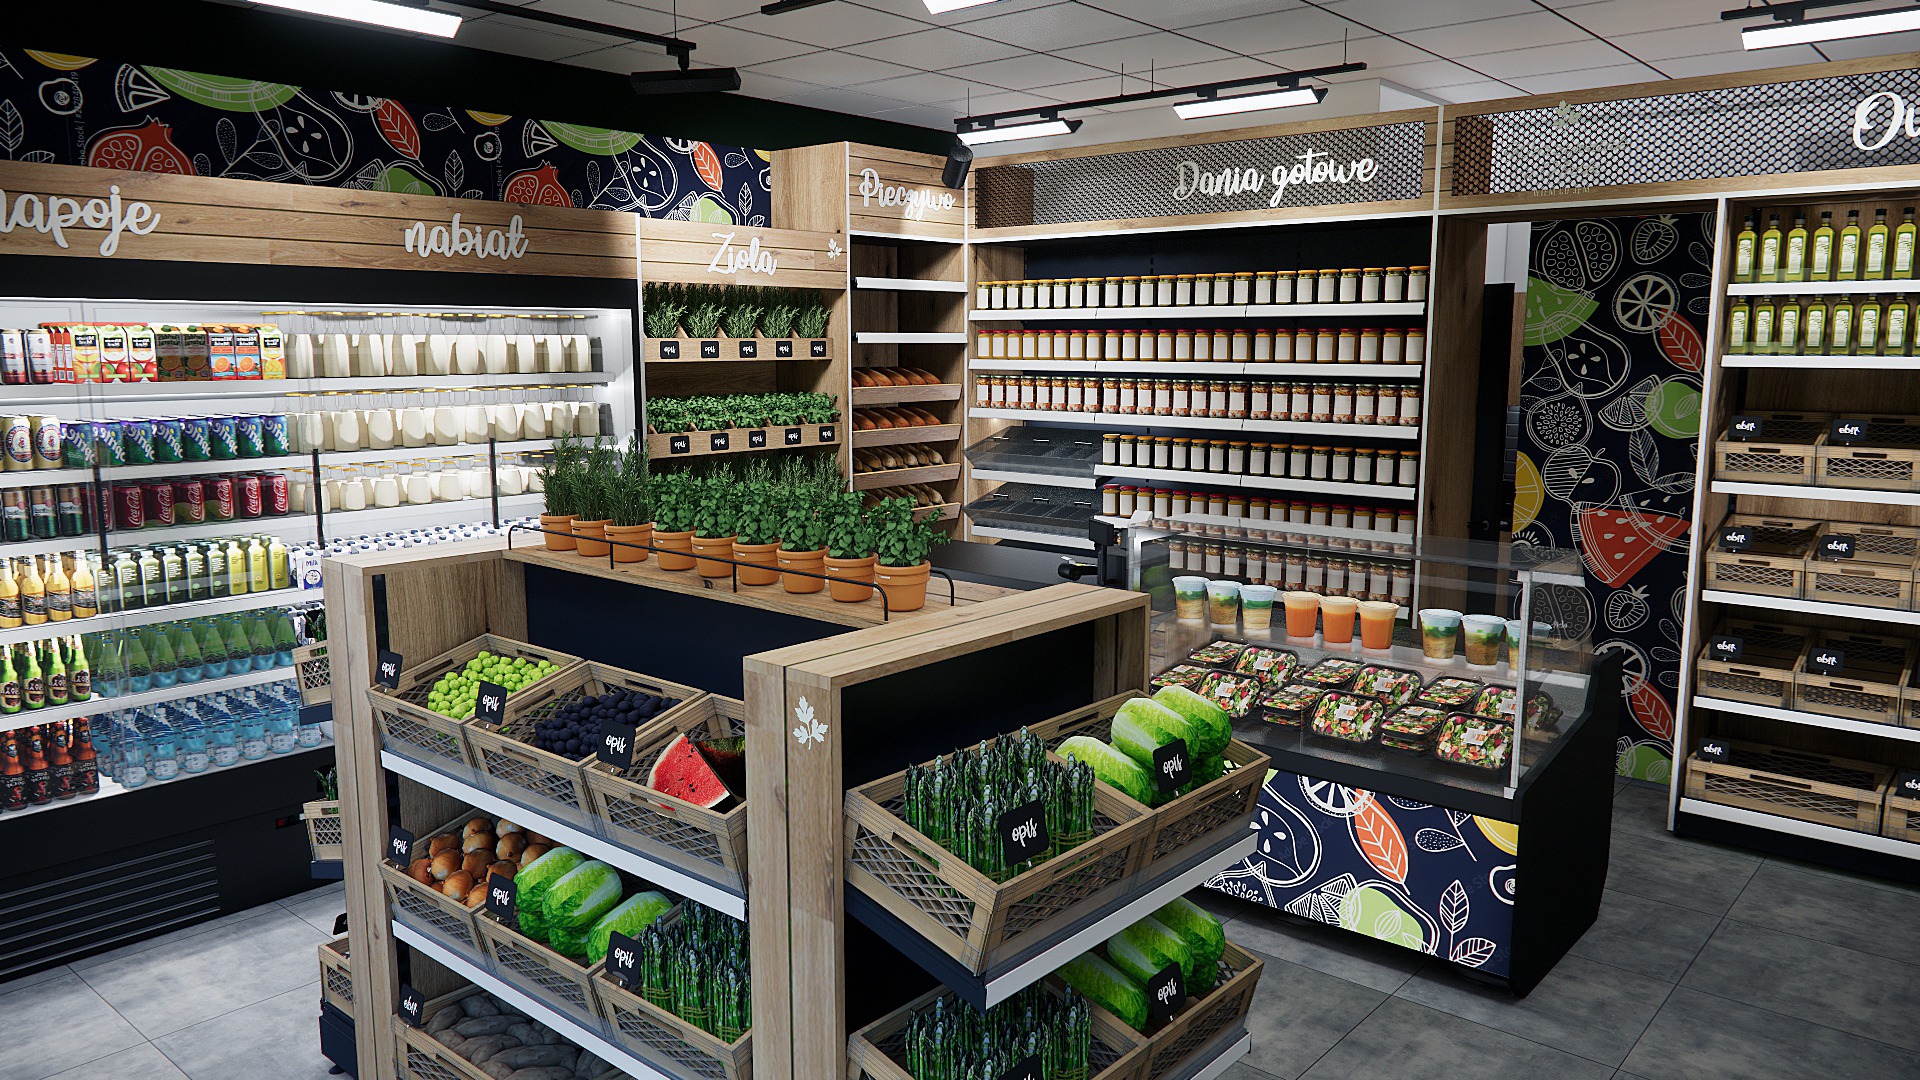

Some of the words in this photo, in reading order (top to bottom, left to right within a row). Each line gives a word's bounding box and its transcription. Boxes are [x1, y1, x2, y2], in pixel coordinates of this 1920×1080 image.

[1173, 160, 1264, 201] Dania
[1269, 147, 1379, 208] gotowe
[858, 167, 957, 221] Pieczywo
[381, 661, 396, 679] opis
[482, 694, 500, 713] opis
[605, 734, 627, 755] opis
[1163, 754, 1182, 778] opis
[1012, 818, 1037, 847] opis
[392, 838, 408, 855] opis
[492, 887, 510, 906] opis
[614, 947, 635, 969] opis
[1158, 978, 1176, 1004] opis
